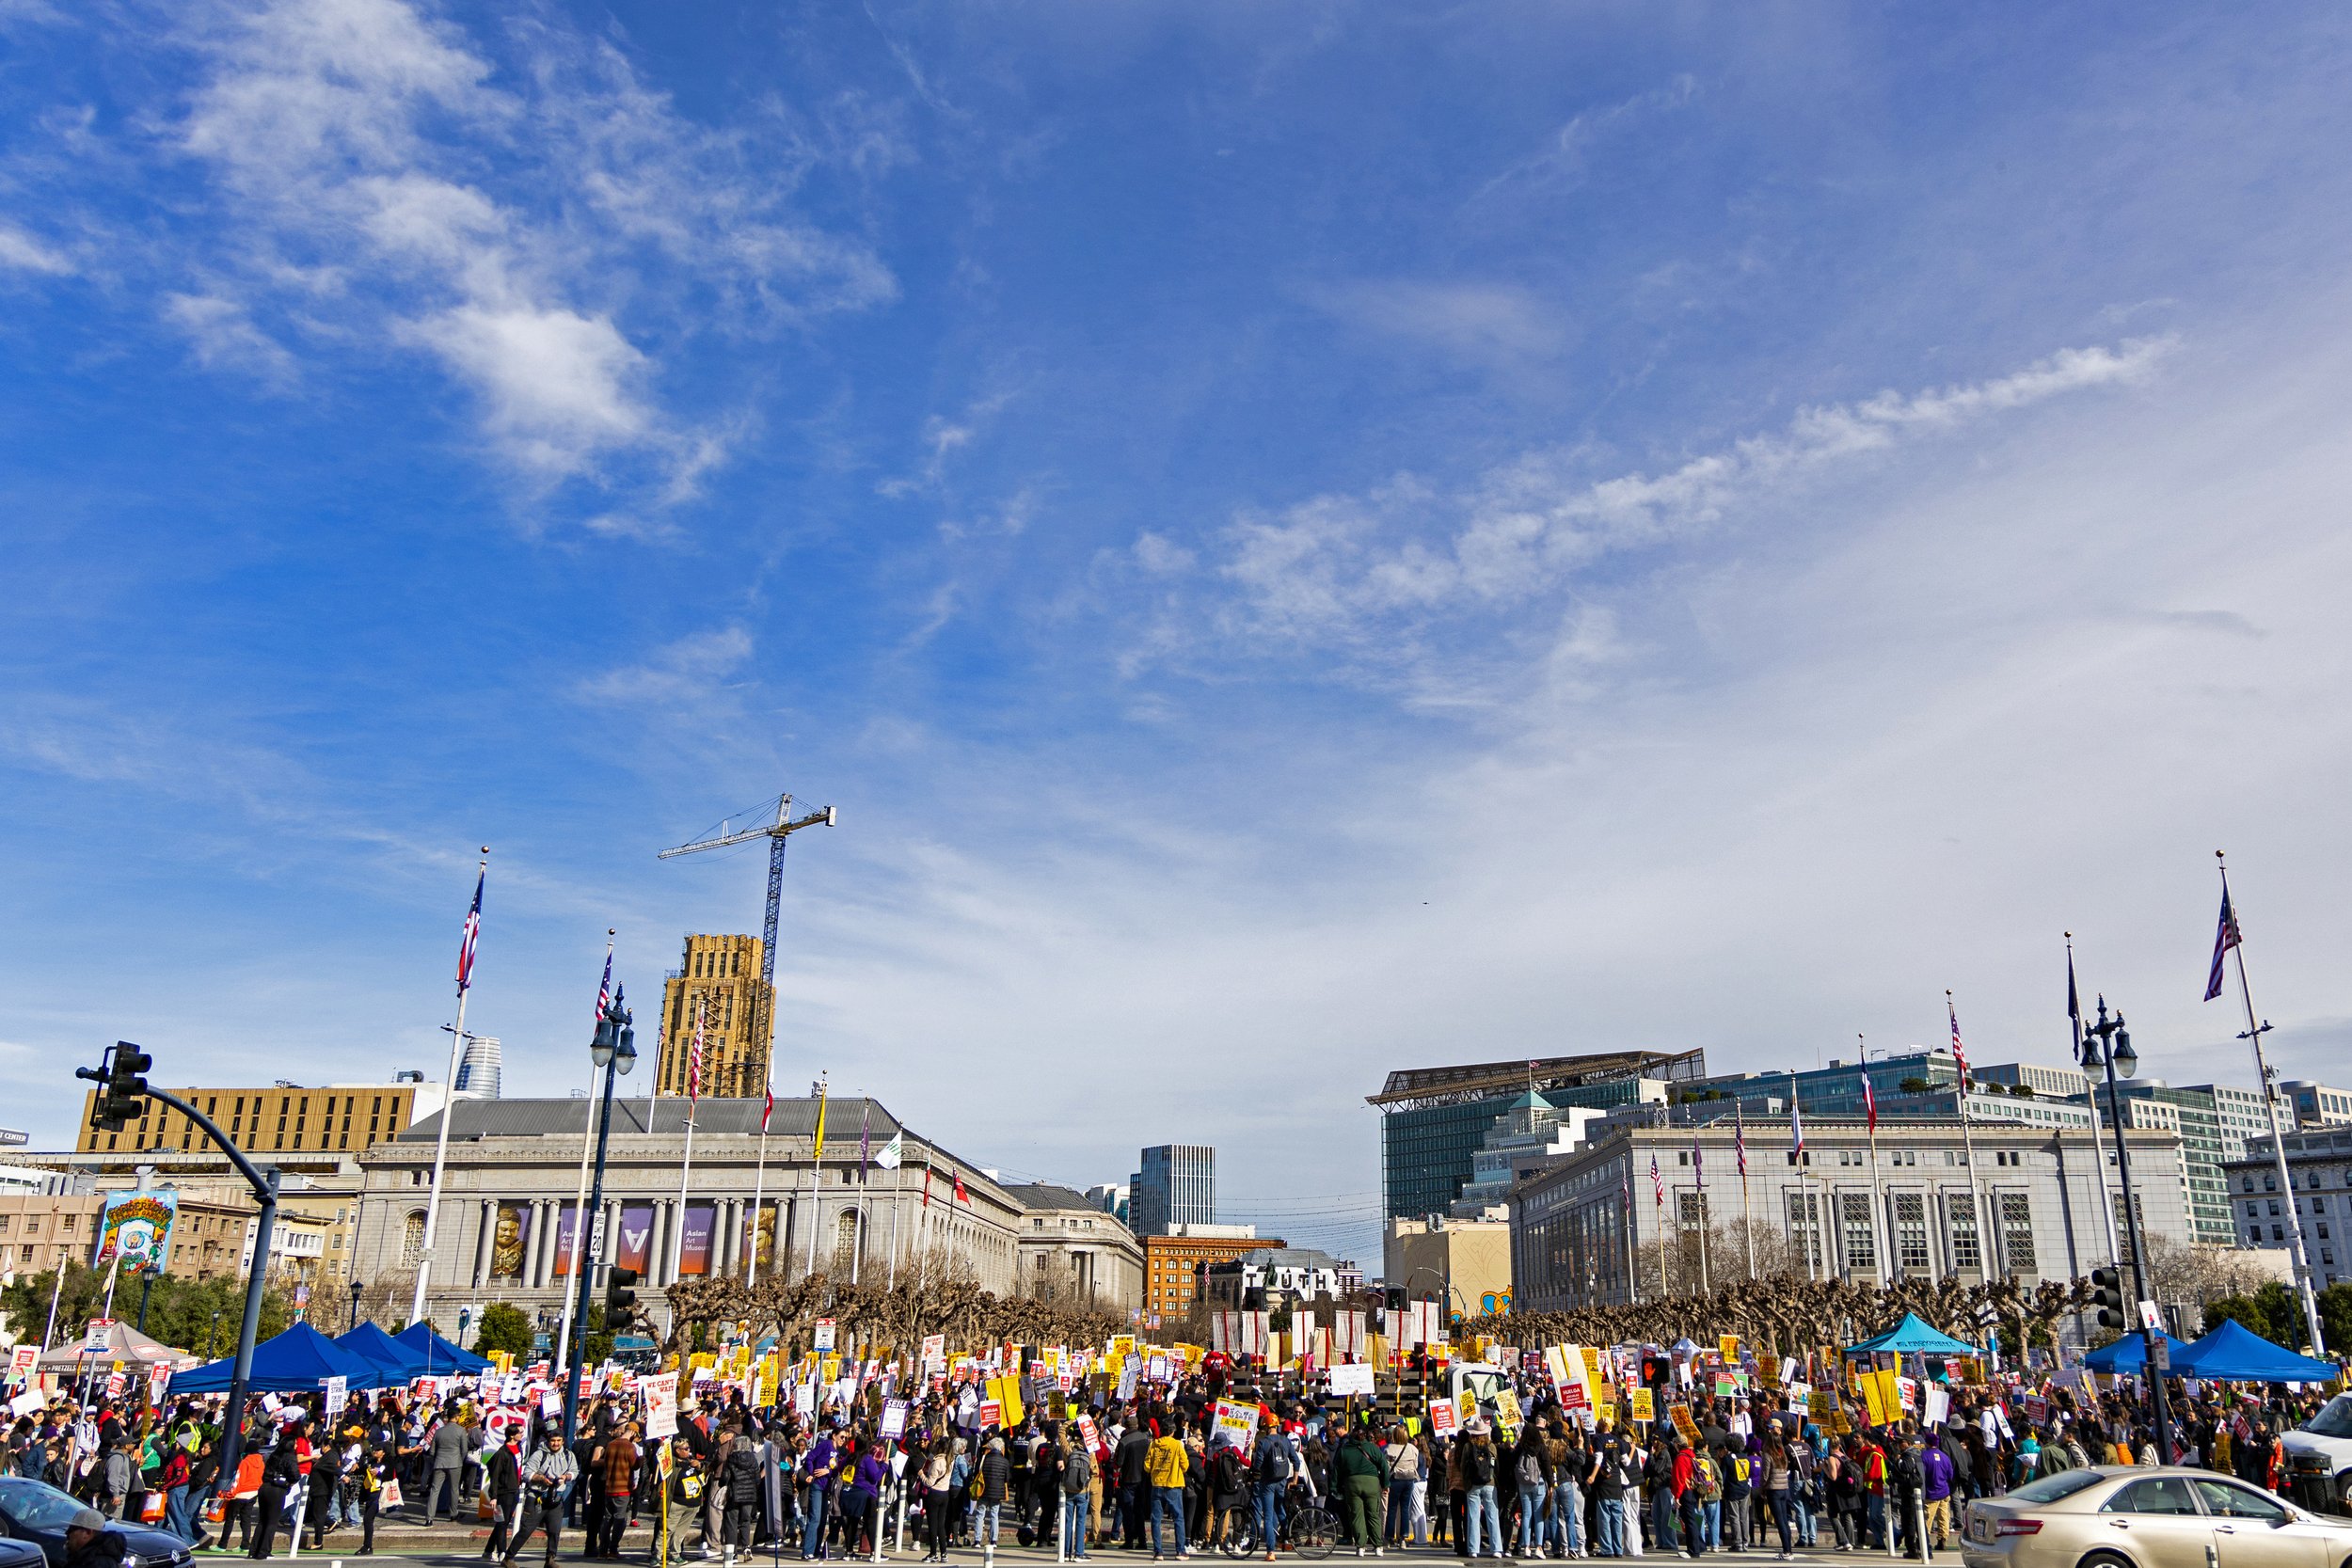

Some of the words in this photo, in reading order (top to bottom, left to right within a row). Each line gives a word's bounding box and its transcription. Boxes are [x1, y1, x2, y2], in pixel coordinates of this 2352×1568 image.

[5, 1132, 26, 1142] CENTER
[647, 1169, 701, 1179] MUSEM
[592, 1235, 602, 1252] 20
[1247, 1273, 1326, 1290] TUTH
[542, 1388, 559, 1398] SEIU
[885, 1399, 907, 1408] SEIU
